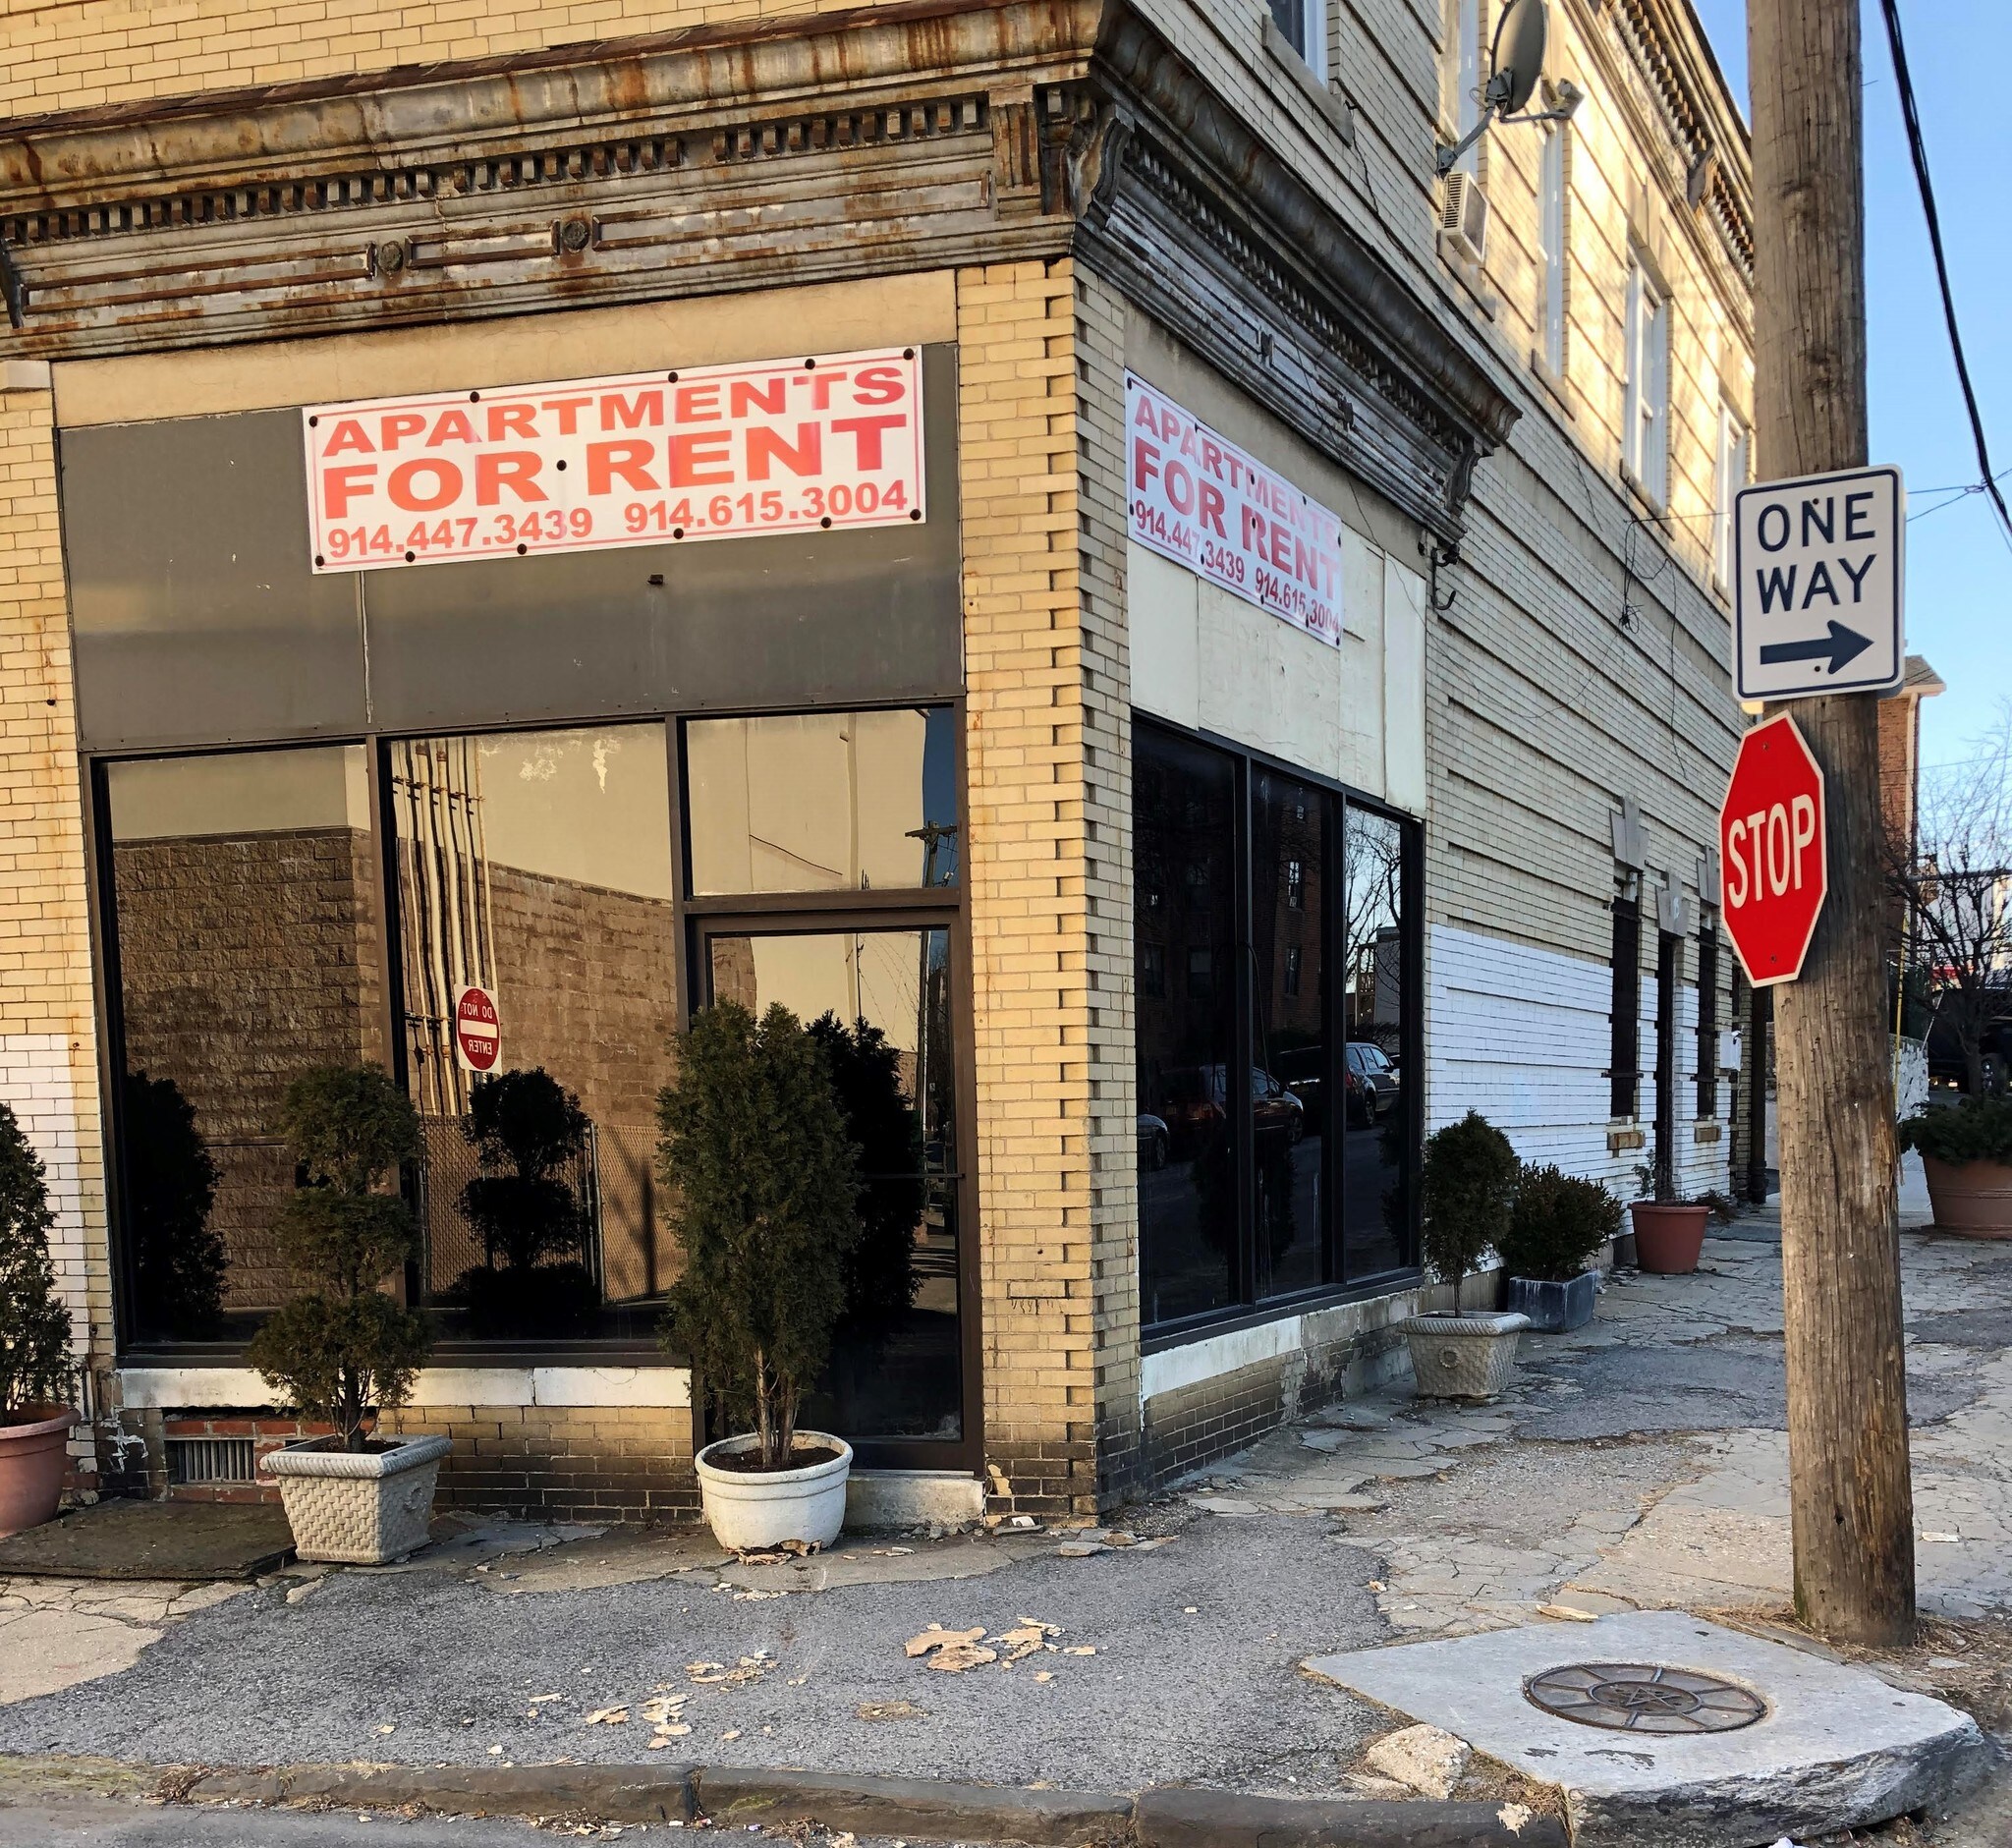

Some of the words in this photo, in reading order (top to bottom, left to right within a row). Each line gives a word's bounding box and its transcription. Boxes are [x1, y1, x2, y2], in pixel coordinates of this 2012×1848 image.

[322, 366, 906, 458] APARTMENTS
[323, 451, 549, 520] FOR
[587, 414, 907, 496] RENT
[1134, 394, 1337, 552] APARTMENTS
[327, 507, 593, 559] 914.447.3439
[624, 479, 908, 532] 914.615.3004
[1135, 435, 1228, 540] FOR
[1241, 503, 1339, 601] RENT
[1136, 499, 1245, 583] 914.4473439
[1758, 491, 1875, 552] ONE
[1757, 553, 1876, 614] WAY
[1728, 793, 1816, 909] STOP
